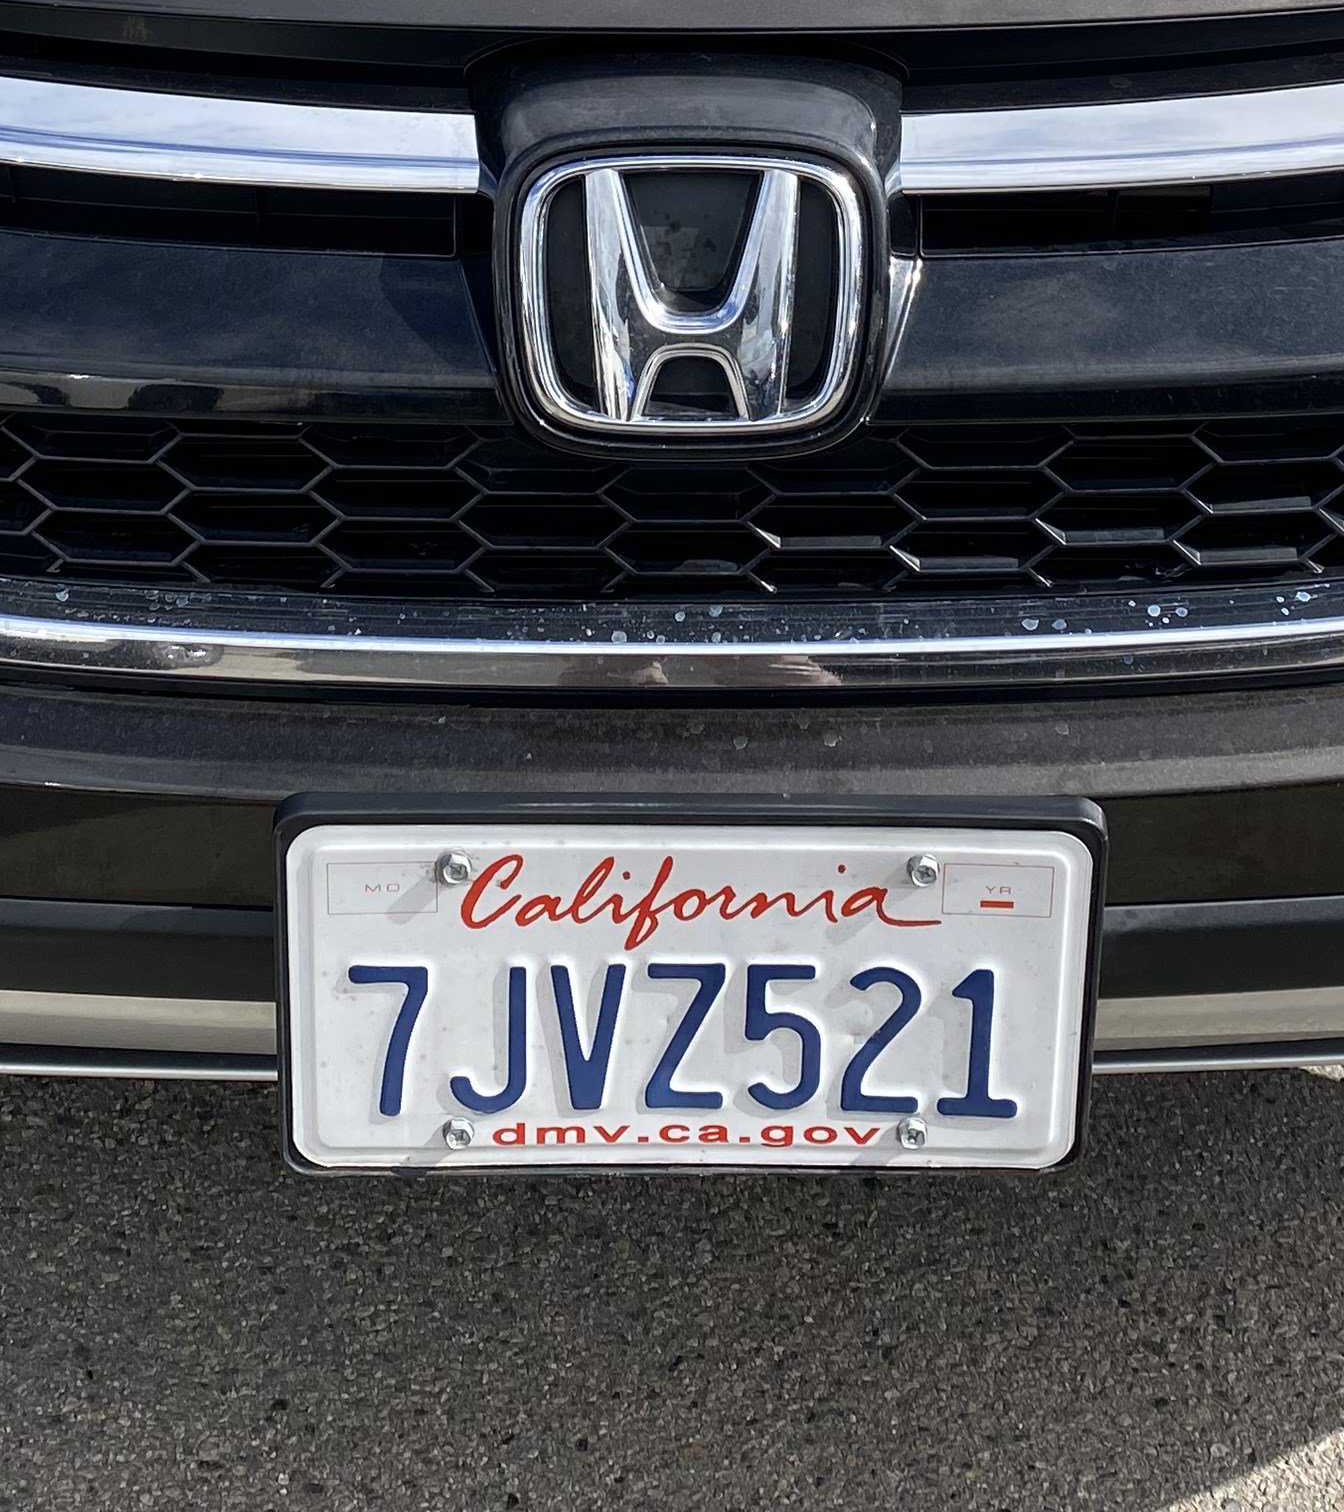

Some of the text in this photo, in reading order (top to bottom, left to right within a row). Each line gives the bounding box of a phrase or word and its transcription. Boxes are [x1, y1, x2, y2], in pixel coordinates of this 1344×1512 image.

[365, 883, 401, 893] MO
[985, 885, 1012, 895] YR
[460, 854, 943, 951] California
[348, 964, 1019, 1119] 7JVZ521
[492, 1122, 881, 1148] dmv.ca.gov
